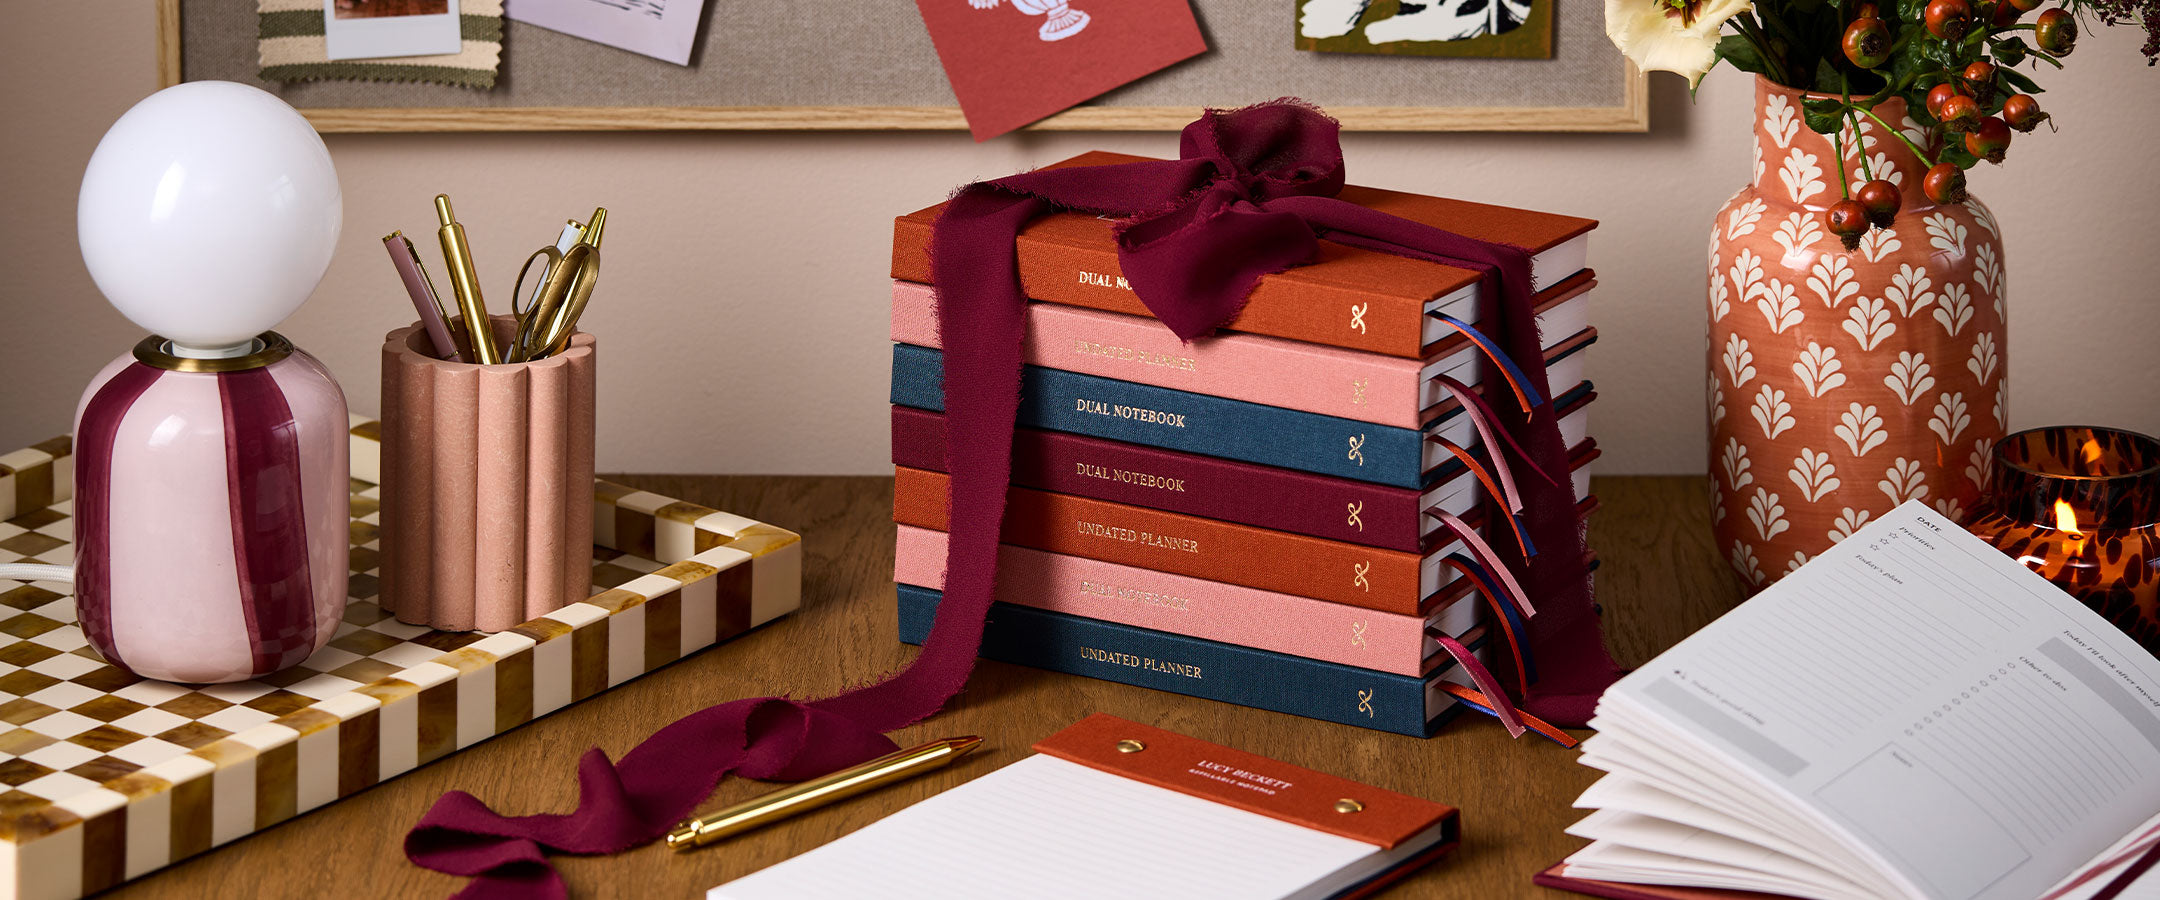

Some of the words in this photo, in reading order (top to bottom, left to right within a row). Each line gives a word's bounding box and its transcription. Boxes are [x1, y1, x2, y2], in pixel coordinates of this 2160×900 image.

[1079, 271, 1112, 288] DUAL
[1075, 340, 1133, 361] UNDATED
[1138, 351, 1196, 372] PLANNER
[1076, 398, 1110, 415] DUAL
[1113, 404, 1185, 428] NOTEBOOK
[1076, 462, 1110, 479] DUAL
[1113, 468, 1185, 492] NOTEBOOK
[1078, 520, 1136, 542] UNDATED
[1140, 532, 1198, 553] PLANNER
[1899, 526, 1936, 550] Priorities
[1917, 516, 1942, 532] DATE
[1882, 571, 1903, 585] plan
[1081, 581, 1114, 598] DUAL
[1118, 587, 1189, 611] NOTEBOOK
[1080, 645, 1140, 668] UNDATED
[1144, 658, 1202, 679] PLANNER
[2019, 656, 2042, 672] Other
[2063, 630, 2088, 648] Today
[2098, 655, 2117, 669] look
[2115, 669, 2136, 685] after
[1197, 760, 1234, 773] LUCY
[1232, 769, 1293, 789] BECKETT
